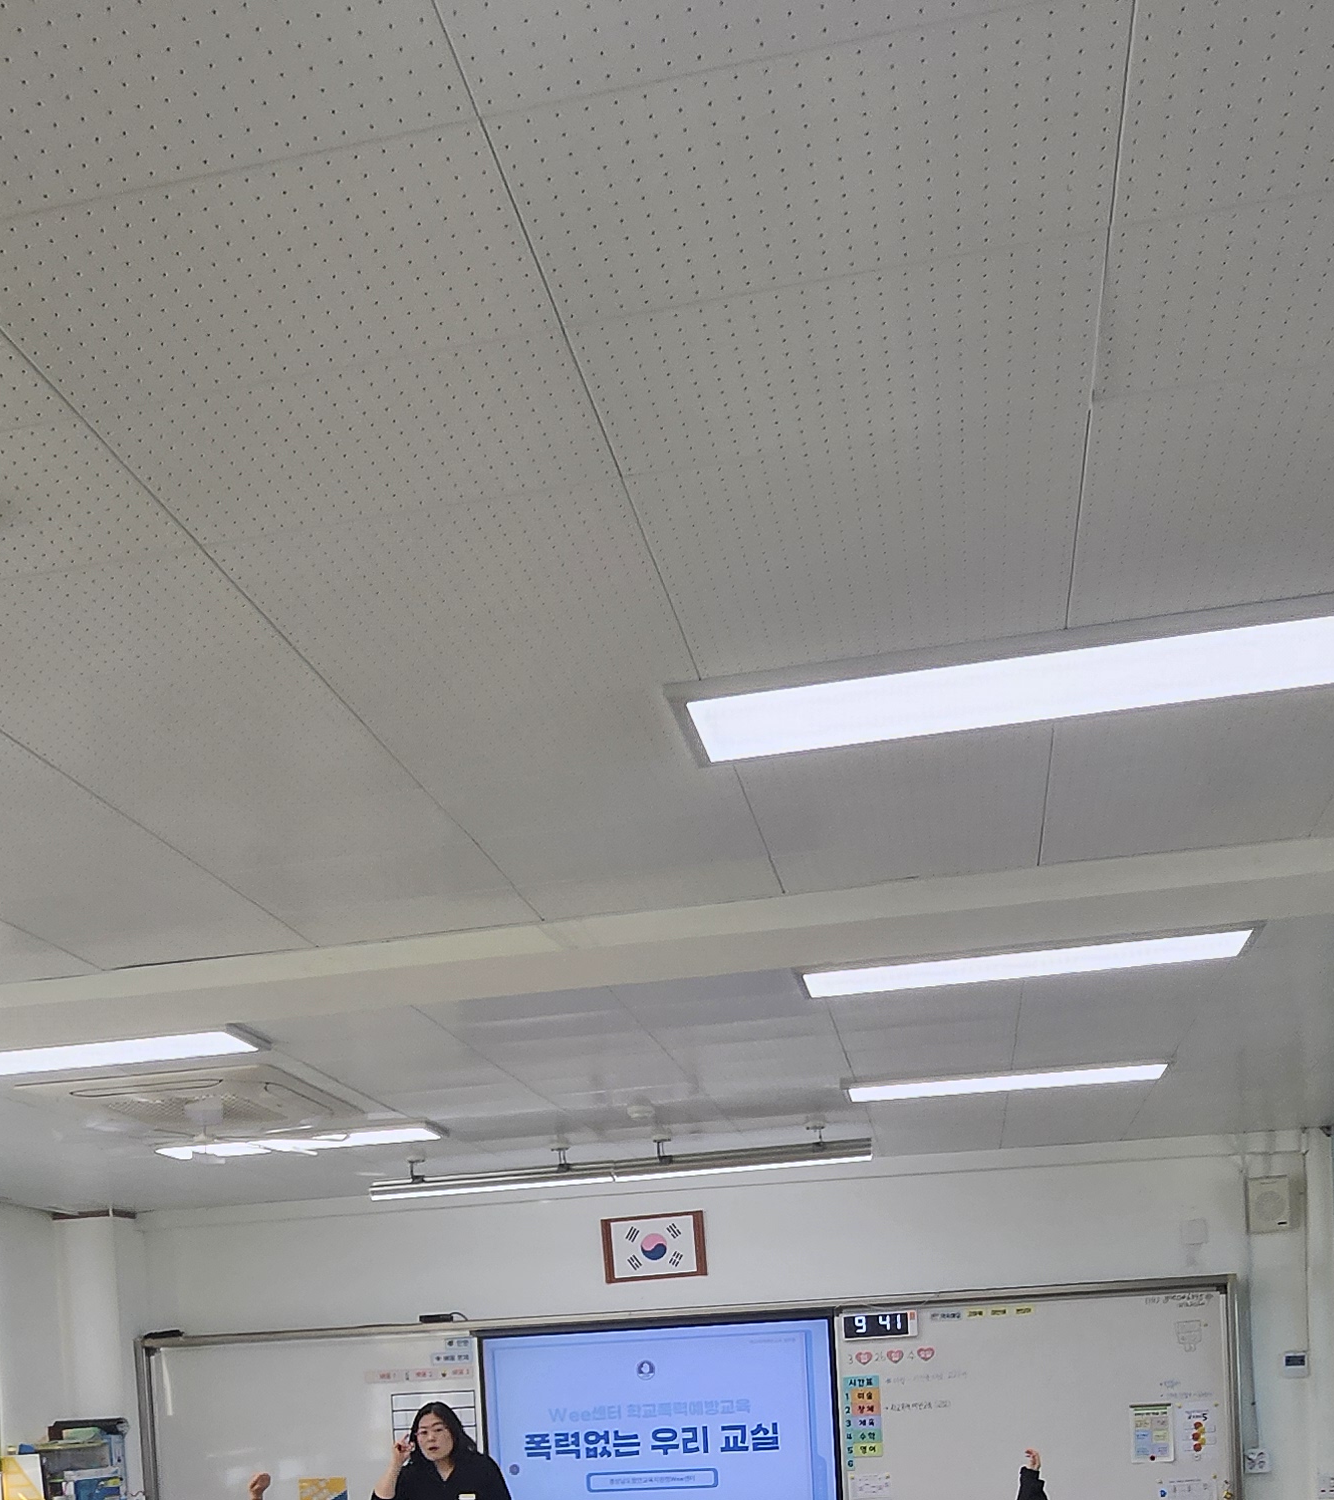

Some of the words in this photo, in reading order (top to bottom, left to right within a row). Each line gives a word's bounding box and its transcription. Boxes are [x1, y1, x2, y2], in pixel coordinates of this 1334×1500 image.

[855, 1315, 866, 1333] 9
[878, 1314, 901, 1330] 41
[549, 1404, 621, 1423] Wee센터
[627, 1398, 752, 1419] 학교폭력예방교육
[524, 1430, 641, 1460] 폭력없는
[650, 1425, 710, 1456] 우리
[720, 1422, 780, 1452] 교실
